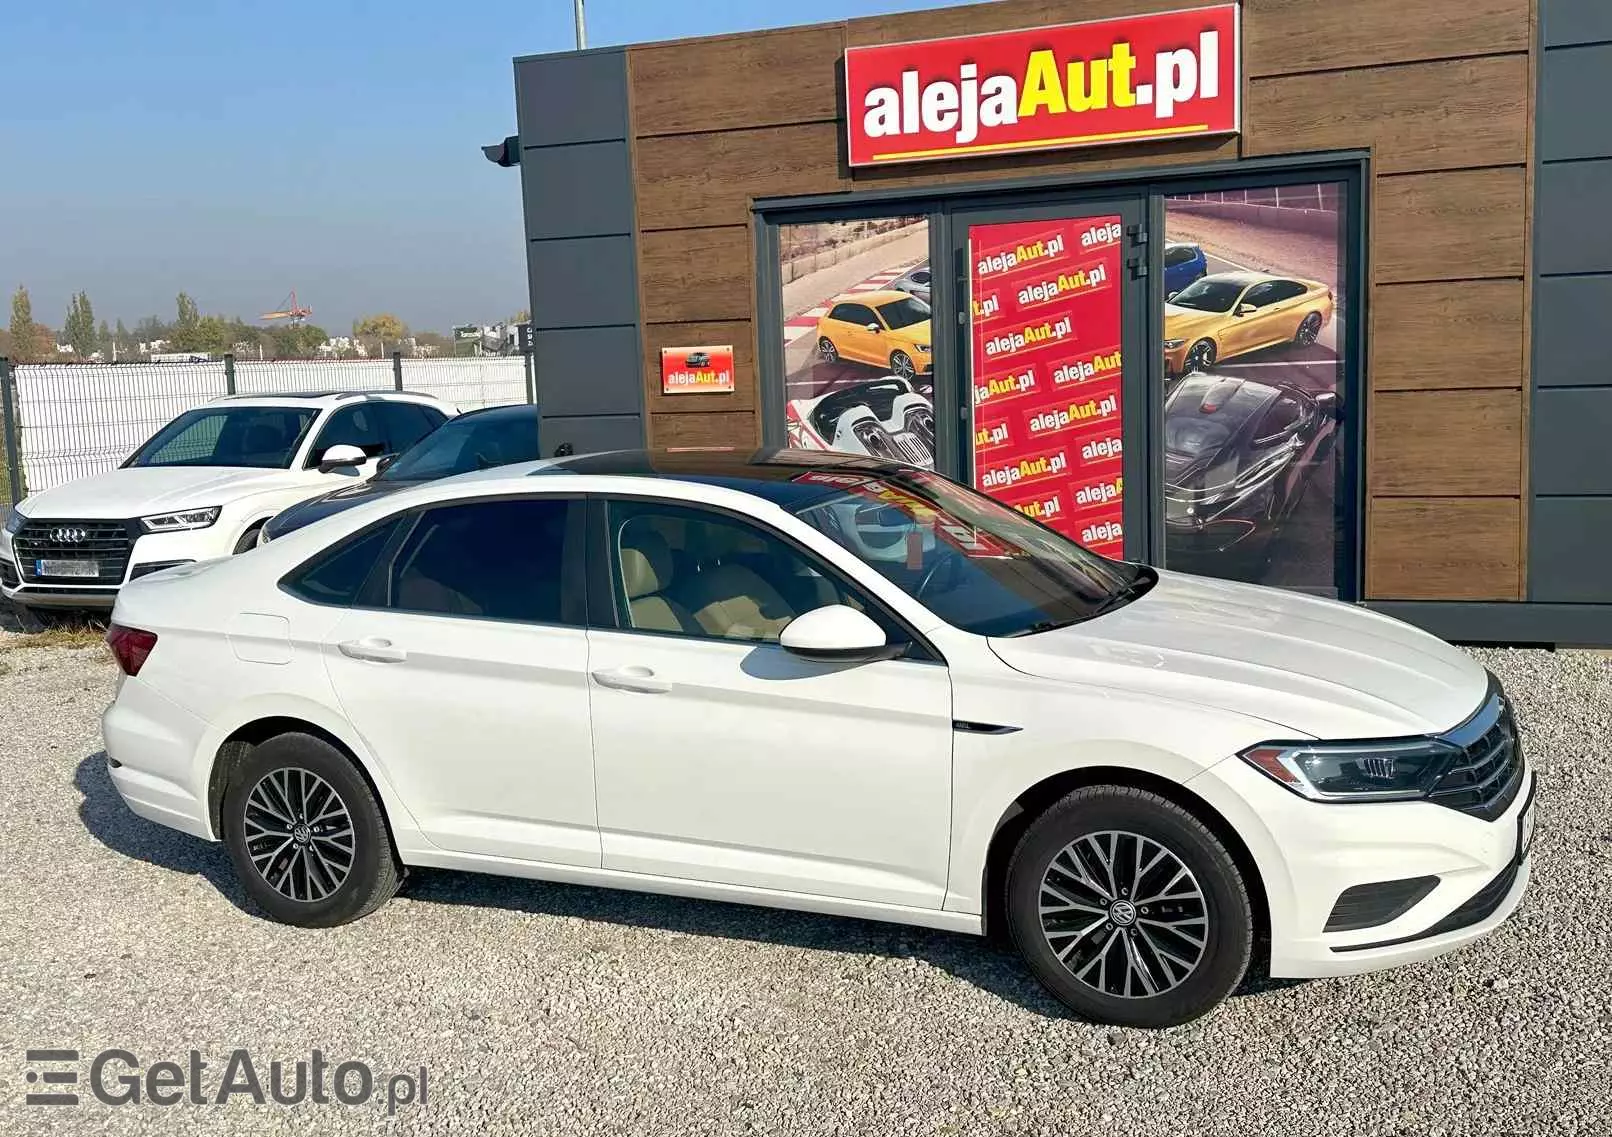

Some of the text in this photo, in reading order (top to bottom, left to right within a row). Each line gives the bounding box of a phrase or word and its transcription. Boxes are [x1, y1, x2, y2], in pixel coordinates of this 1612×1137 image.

[863, 30, 1219, 144] alejaAut.pl
[977, 234, 1065, 276] alejaAut.pl
[1017, 263, 1107, 305] alejaAut.pl
[985, 316, 1073, 356] alejaAut.pl
[667, 369, 730, 386] alejaAut.pl
[1029, 394, 1118, 433] alejaAut.pl
[1081, 437, 1123, 460] aleja
[982, 451, 1068, 487] alejaAut.pl
[1081, 521, 1123, 543] aleja
